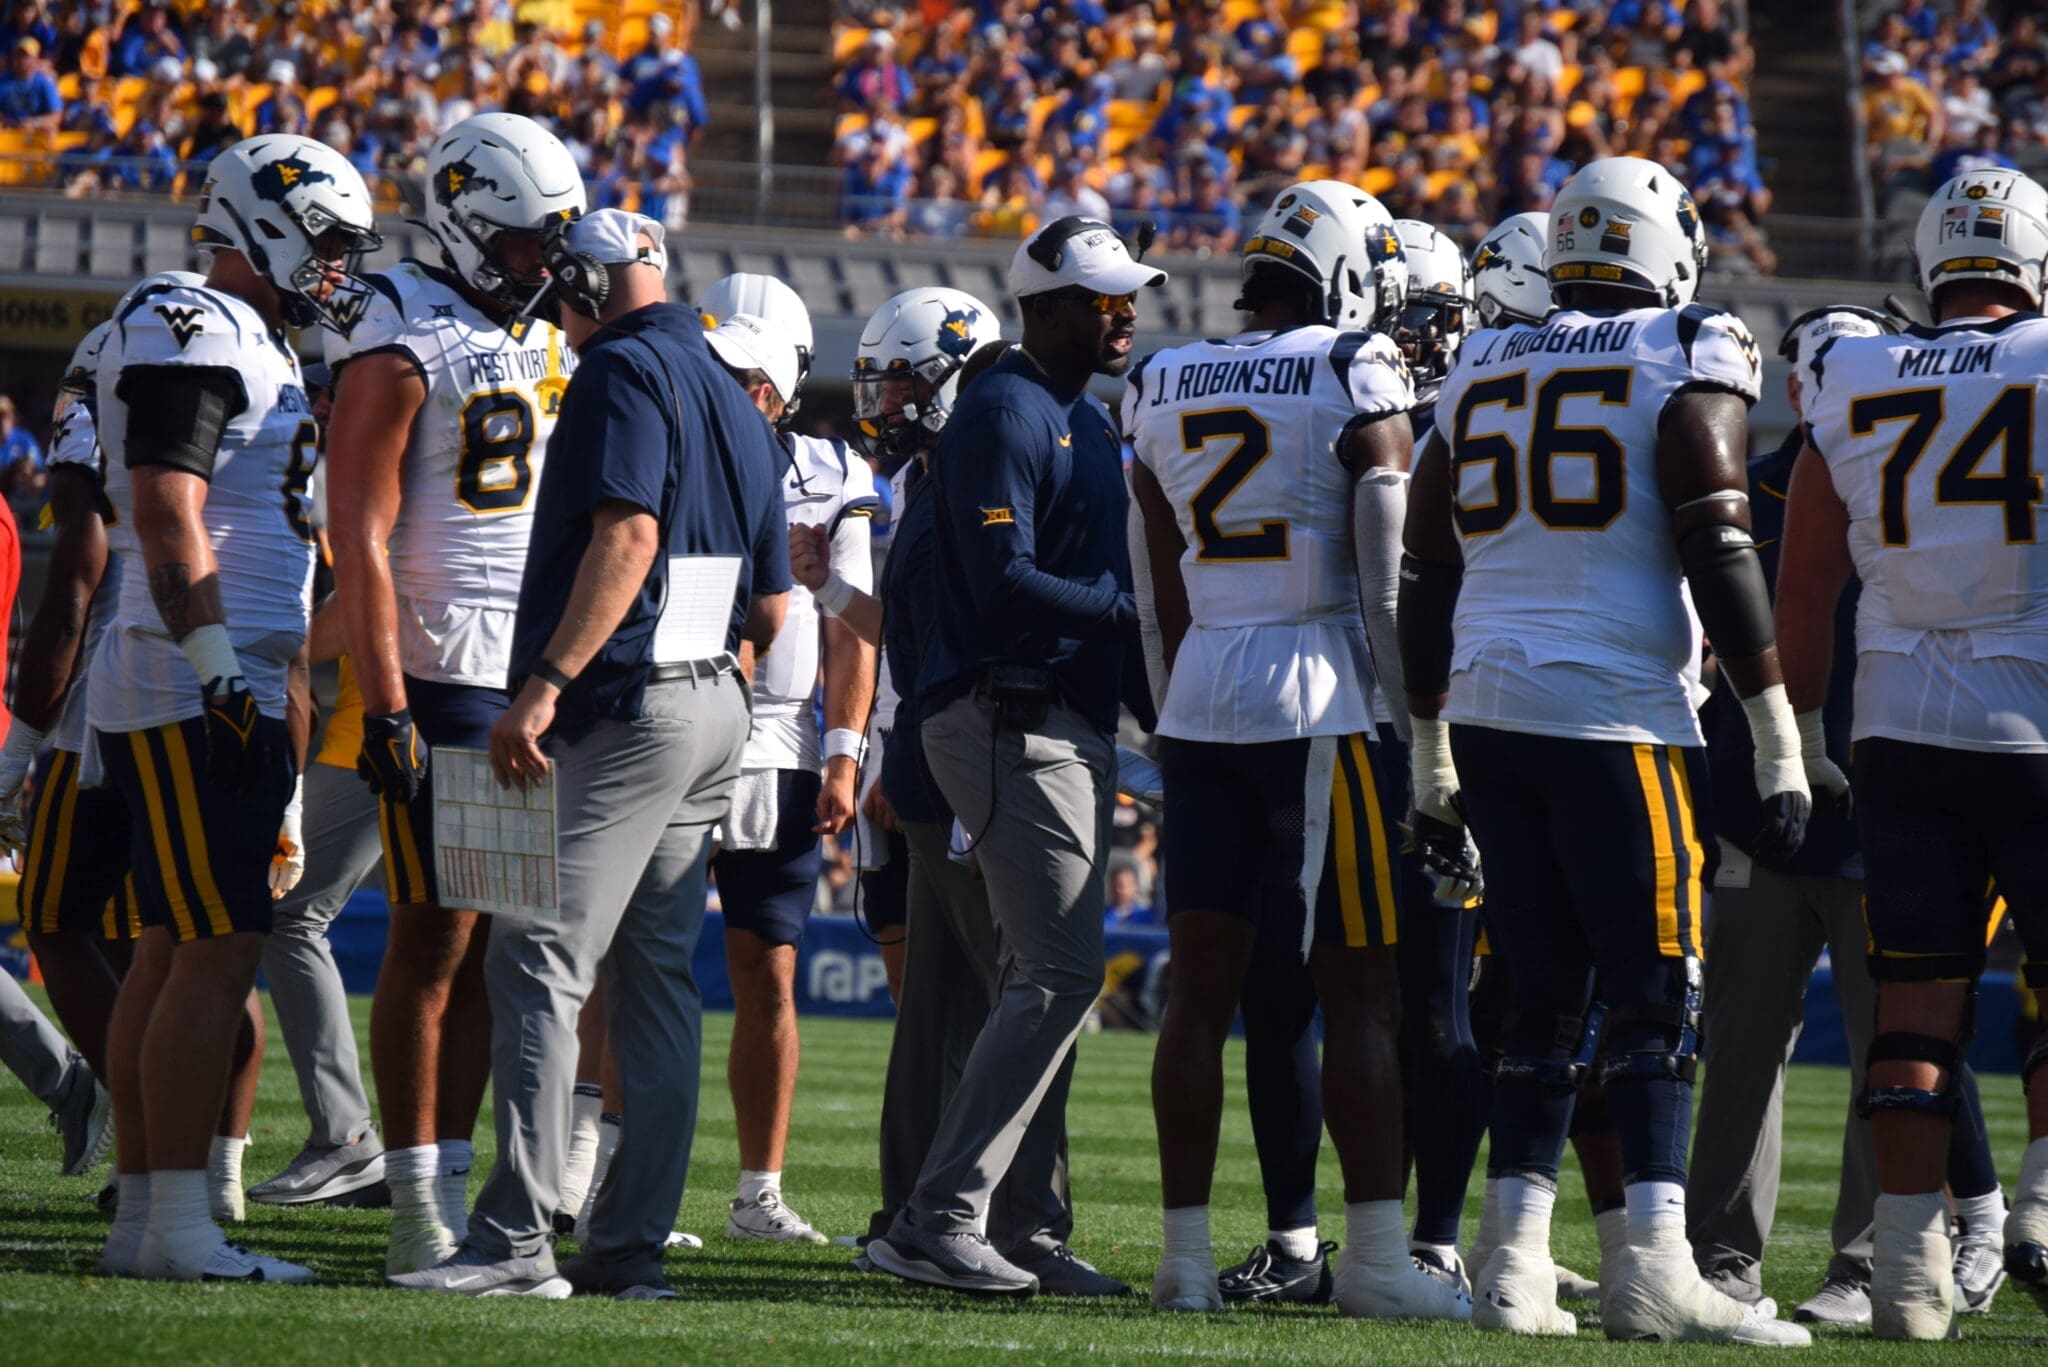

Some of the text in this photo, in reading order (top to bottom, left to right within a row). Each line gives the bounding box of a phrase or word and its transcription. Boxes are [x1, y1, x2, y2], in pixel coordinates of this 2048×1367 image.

[1083, 233, 1106, 249] WEST
[1556, 230, 1575, 252] 66
[1944, 219, 1967, 239] 74
[1473, 320, 1636, 367] J. HUBBARD
[1900, 342, 1998, 378] MILUM
[466, 352, 512, 384] WEST
[1151, 356, 1317, 407] J. ROBINSON
[455, 388, 563, 514] 8
[1451, 365, 1635, 539] 66
[1849, 384, 2045, 549] 74
[1180, 406, 1292, 562] 2
